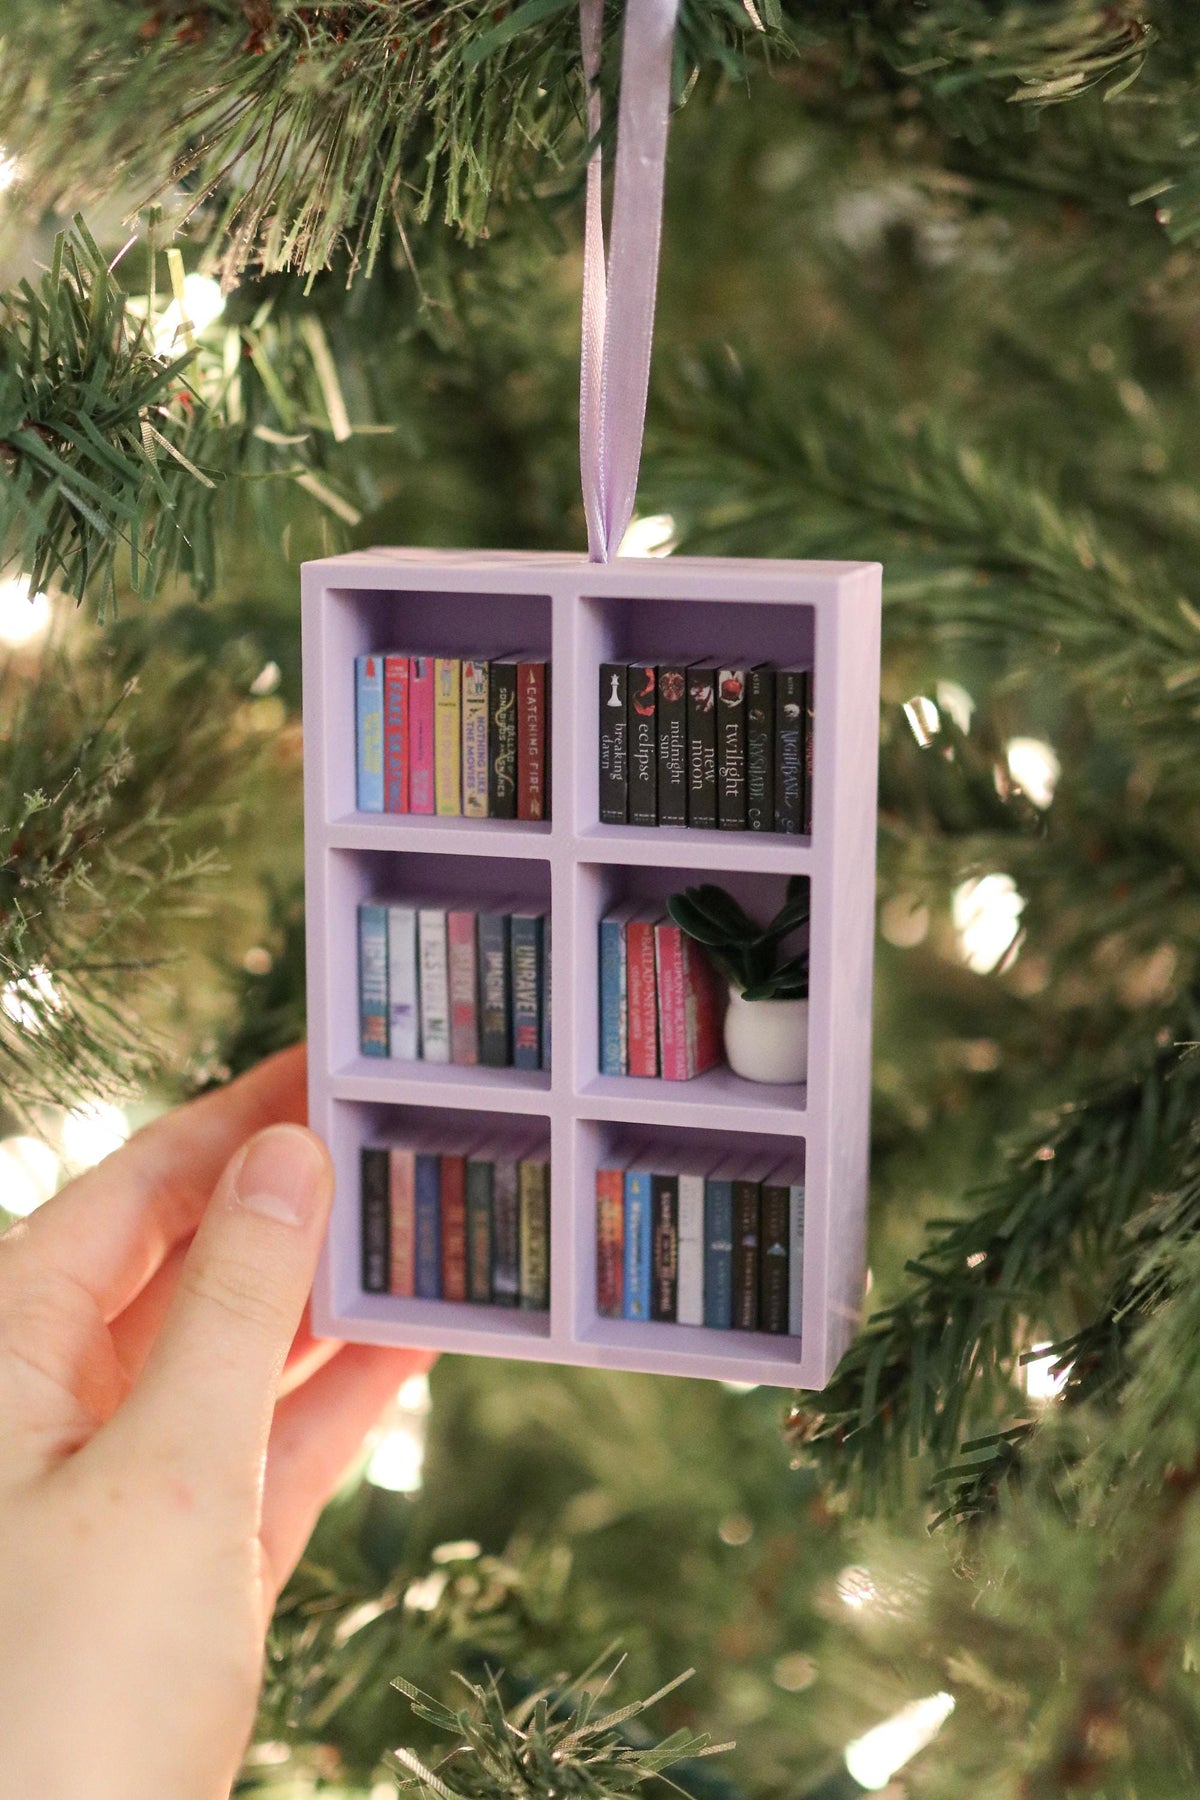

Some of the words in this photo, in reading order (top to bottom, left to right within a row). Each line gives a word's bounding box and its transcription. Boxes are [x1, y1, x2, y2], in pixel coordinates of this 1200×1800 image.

[466, 721, 476, 742] THE
[477, 716, 485, 767] NOTHING
[526, 687, 539, 755] CATCHING
[467, 745, 476, 789] MOVIES
[602, 735, 614, 769] dawn
[610, 723, 626, 780] breaking
[633, 723, 653, 781] eclipse
[660, 734, 670, 760] sun
[667, 721, 683, 784] midnight
[691, 740, 703, 790] moon
[704, 747, 715, 783] new
[719, 723, 743, 797] twilight
[477, 771, 485, 795] LIKE
[529, 761, 540, 793] FIRE
[516, 945, 537, 1019] UNRAVEL
[516, 1025, 537, 1050] ME
